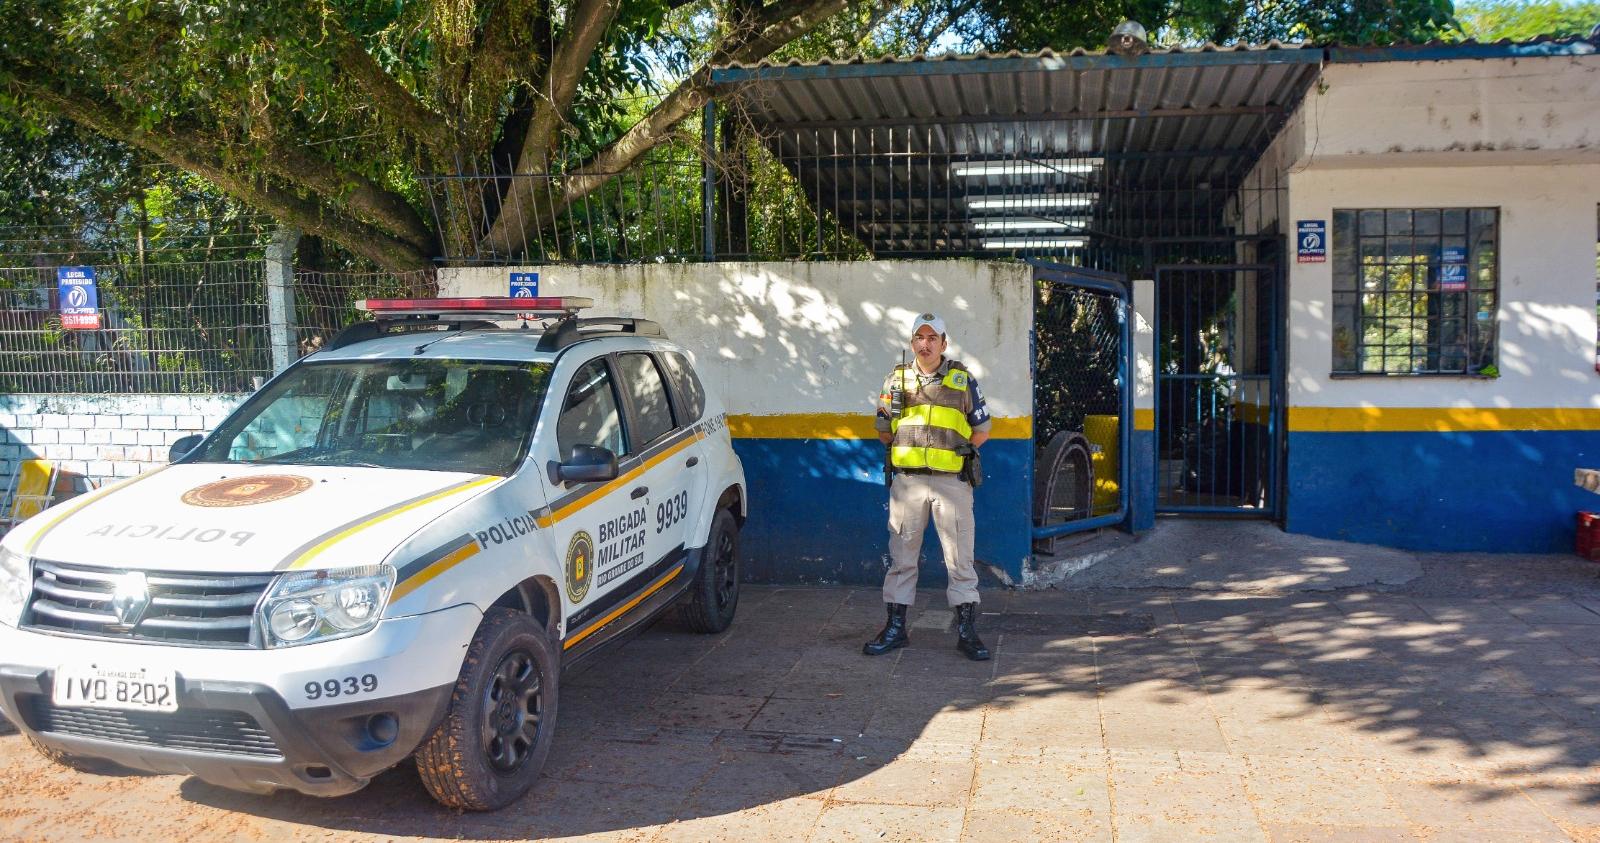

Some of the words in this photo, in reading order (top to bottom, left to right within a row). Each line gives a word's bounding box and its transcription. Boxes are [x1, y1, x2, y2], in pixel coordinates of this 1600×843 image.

[599, 507, 646, 543] BRIGADA
[656, 489, 688, 534] 9939
[476, 515, 538, 550] POLÍCIA
[597, 529, 646, 568] MILITAR
[608, 562, 627, 582] GRANDE
[116, 681, 171, 705] 8202
[304, 673, 378, 700] 9939
